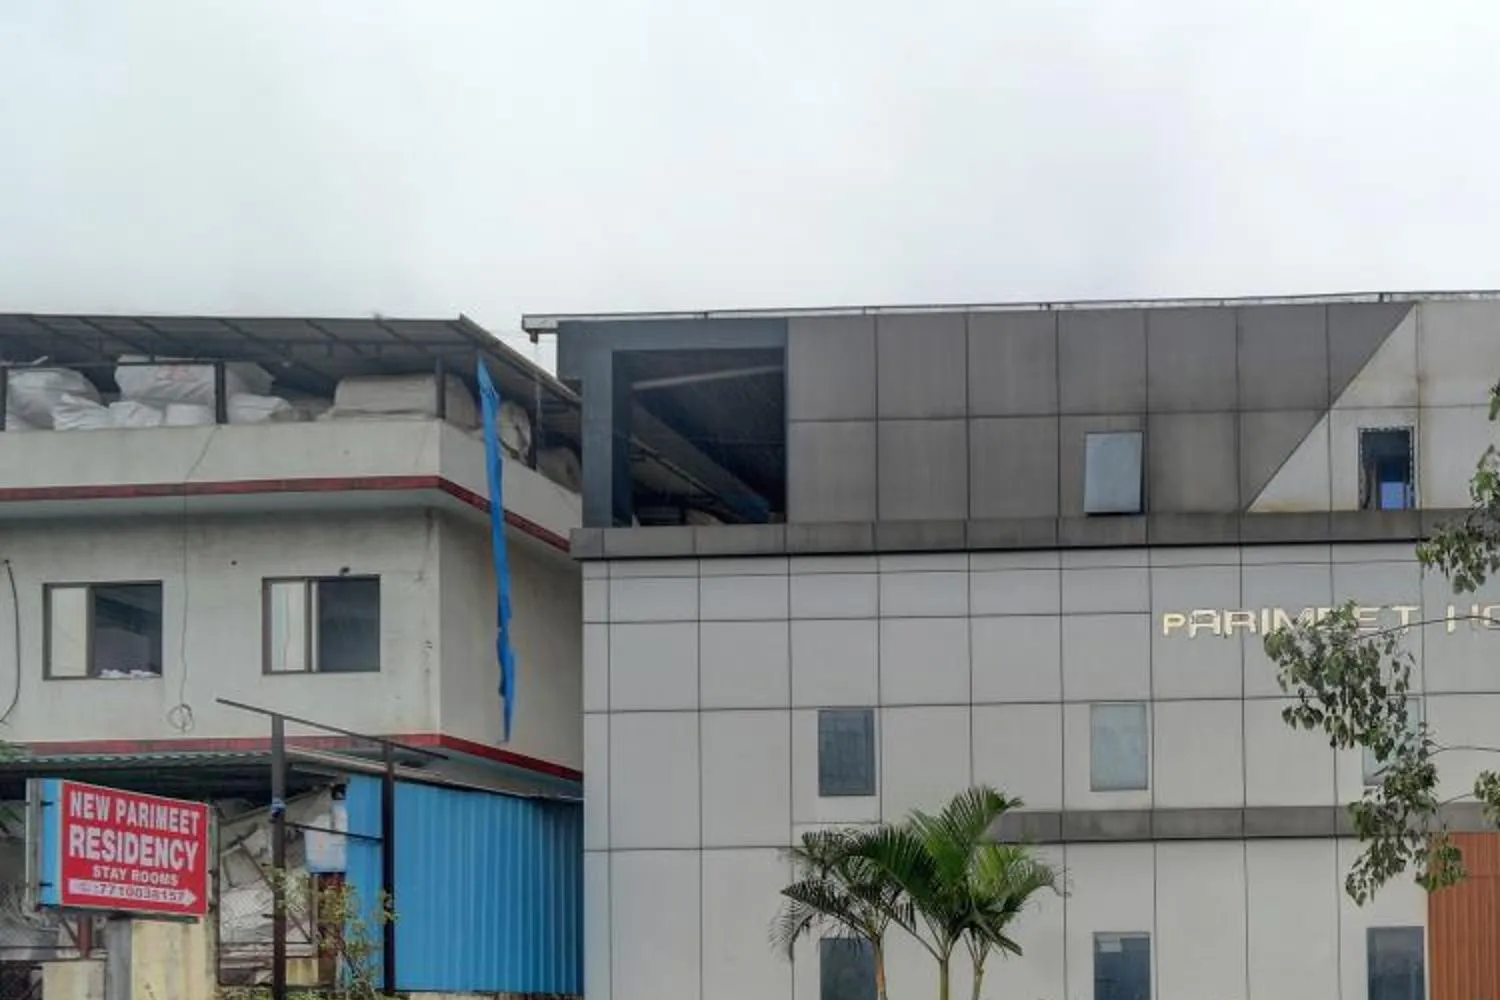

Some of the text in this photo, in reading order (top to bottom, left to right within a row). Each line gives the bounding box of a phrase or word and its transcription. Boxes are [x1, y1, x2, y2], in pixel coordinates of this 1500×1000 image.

[69, 791, 199, 835] NEW PARIMEET
[68, 824, 198, 871] RESIDENCY
[92, 865, 178, 886] STAY ROOMS
